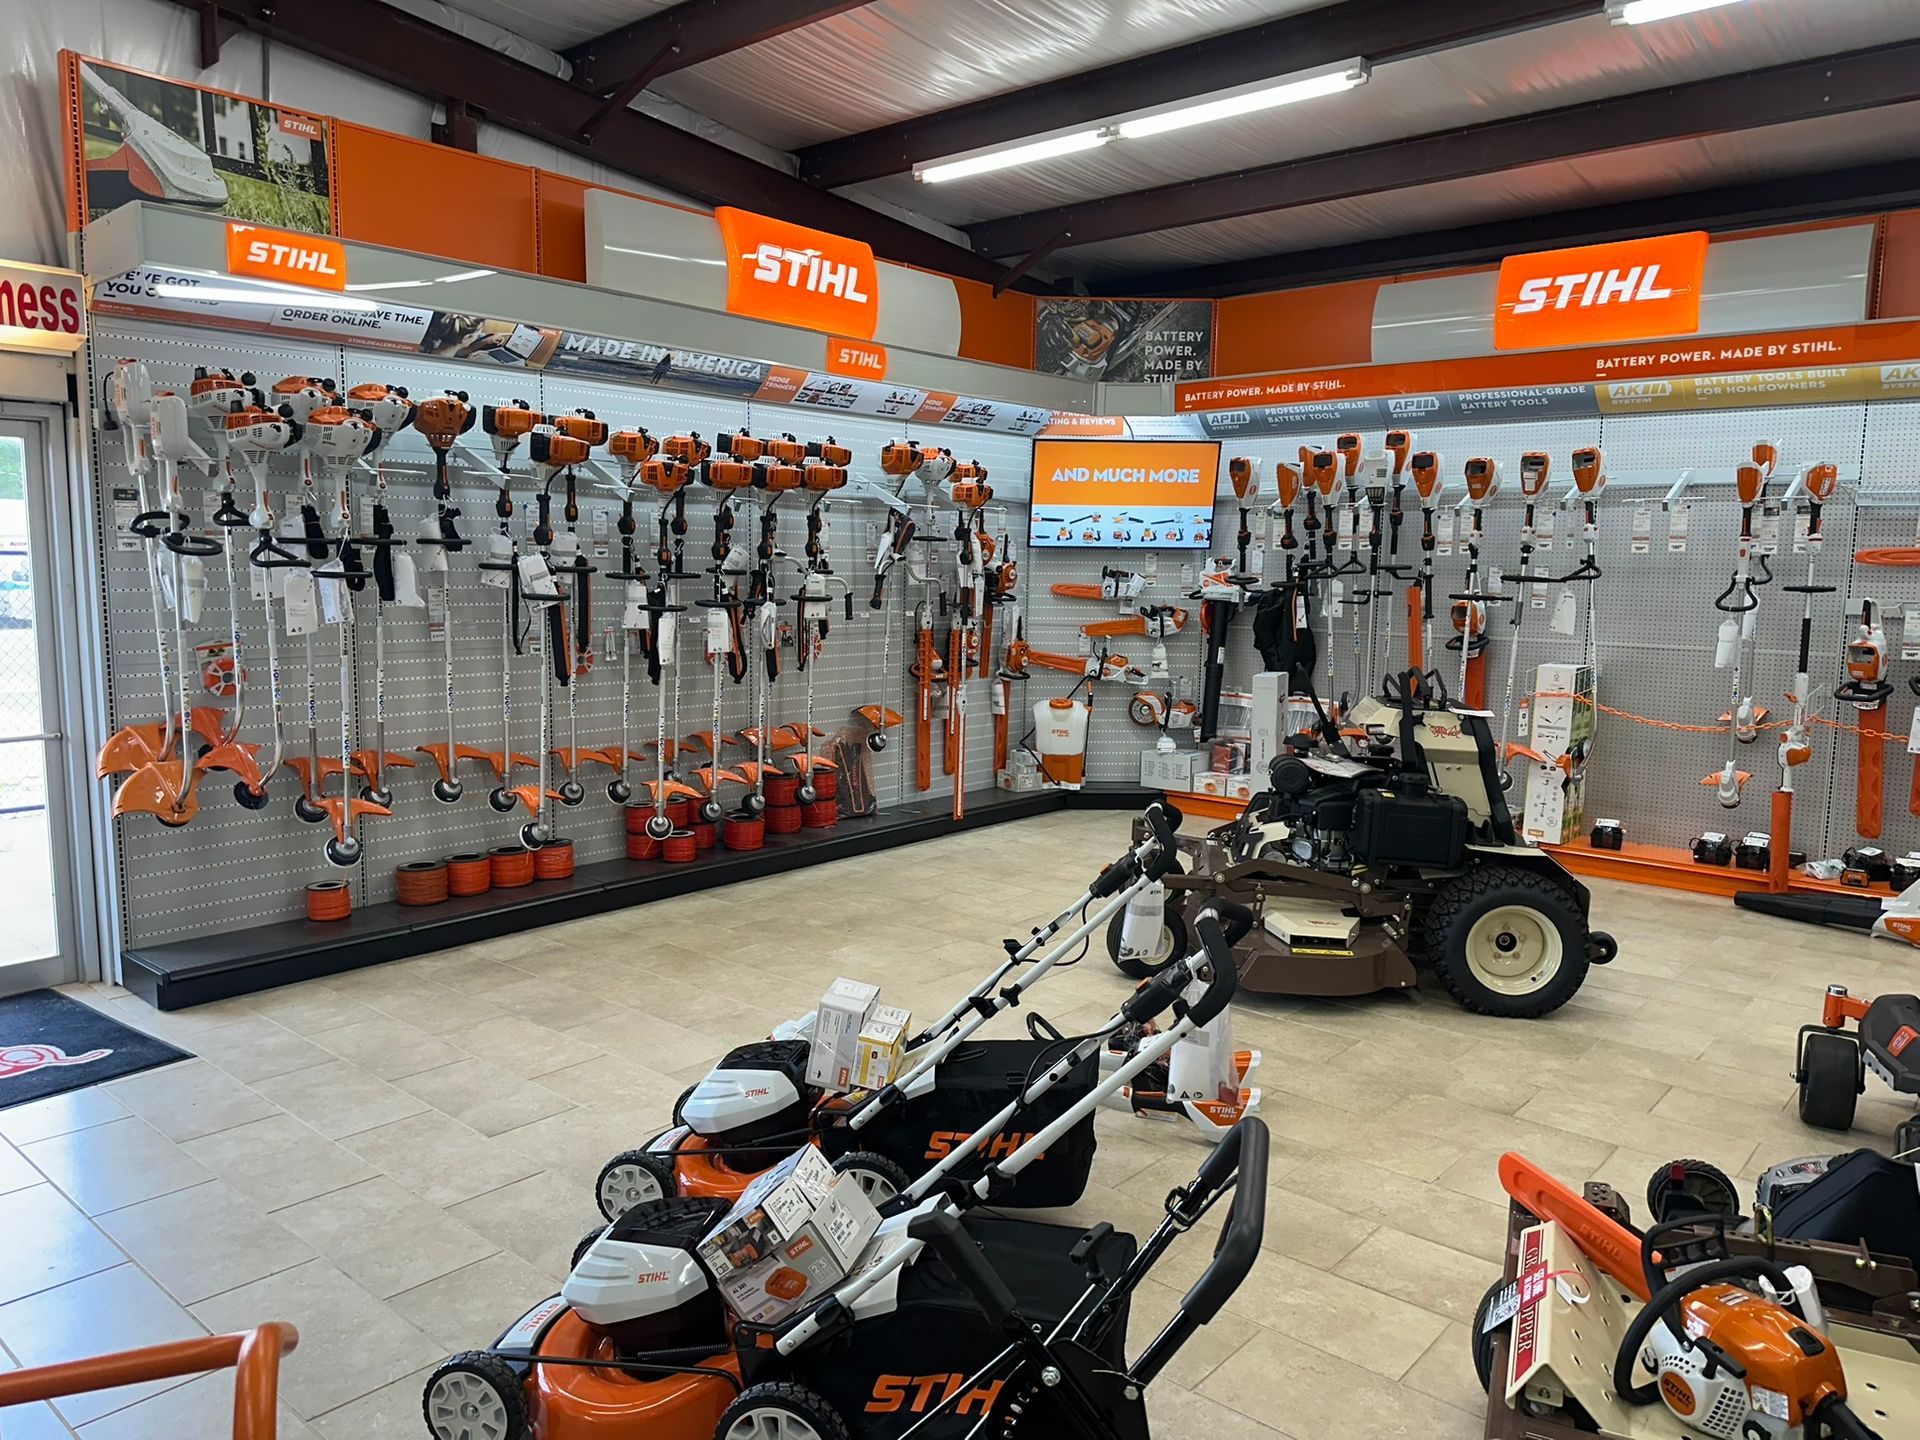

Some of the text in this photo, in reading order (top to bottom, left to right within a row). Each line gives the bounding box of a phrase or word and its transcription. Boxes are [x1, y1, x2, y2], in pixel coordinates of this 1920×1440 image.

[283, 119, 318, 135] STIHL
[247, 241, 336, 275] STIHL
[118, 270, 162, 284] E'VE
[754, 243, 869, 304] STIHL
[106, 281, 142, 295] YOU
[1511, 264, 1673, 315] STIHL
[282, 308, 329, 322] ORDER
[331, 315, 382, 329] ONLINE.
[395, 312, 425, 326] TIME.
[1145, 331, 1204, 342] BATTERY
[347, 338, 413, 351] STIHLDEALERS.COM
[1144, 346, 1197, 356] POWER.
[564, 333, 762, 380] MADE IN AMERICA
[839, 348, 883, 370] STIHL
[1596, 340, 1842, 369] BATTERY POWER. MADE BY STIHL.
[1144, 360, 1203, 371] MADE BY
[768, 376, 791, 384] HEDGE
[1694, 367, 1848, 386] BATTERY TOOLS BUILT
[764, 381, 797, 391] TRIMMERS
[1184, 380, 1346, 402] BATTERY POWER. MADE BY STIHL.
[1458, 385, 1587, 401] PROFESSIONAL-GRADE
[1696, 380, 1826, 396] FOR HOMEOWNERS
[1882, 381, 1920, 390] SYSTE
[1264, 400, 1371, 416] PROFESSIONAL-GRADE
[1461, 397, 1549, 410] BATTERY TOOLS
[1080, 418, 1116, 426] REVIEWS
[1267, 411, 1341, 424] BATTERY TOOLS
[1392, 411, 1426, 419] SYSTEM
[1051, 467, 1200, 484] AND MUCH MORE
[744, 1087, 769, 1098] STIHL
[1209, 1106, 1237, 1115] STIHL
[790, 1239, 810, 1257] STIHL
[1579, 1223, 1623, 1260] STIHL
[638, 1270, 669, 1284] STIHL
[1663, 1378, 1693, 1406] STIHL
